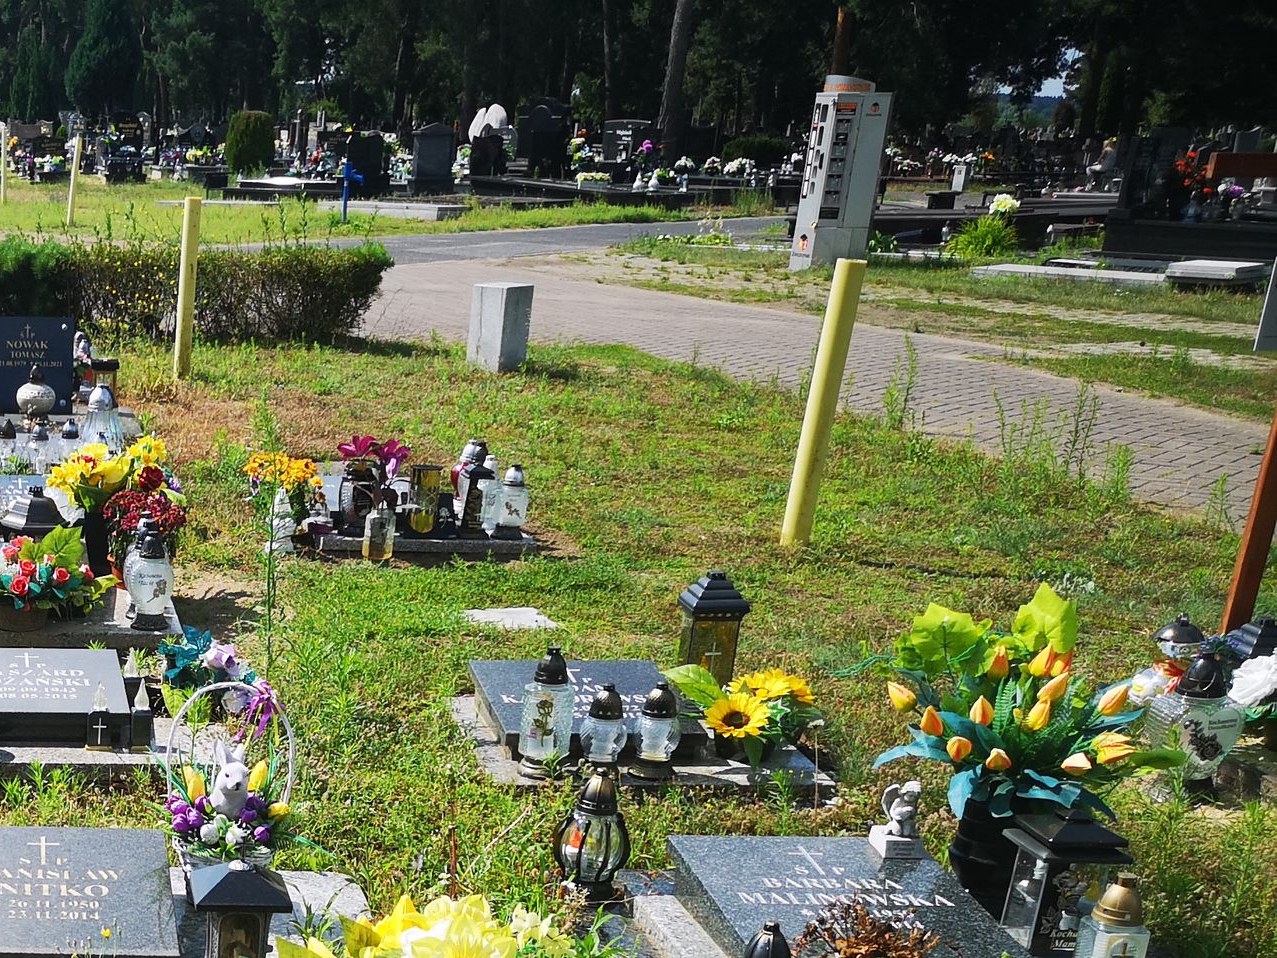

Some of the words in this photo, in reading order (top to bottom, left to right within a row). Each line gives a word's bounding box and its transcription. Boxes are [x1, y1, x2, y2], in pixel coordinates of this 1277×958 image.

[6, 340, 48, 349] NOWAK
[11, 351, 45, 359] TOMASZ
[762, 877, 904, 890] BARBARA
